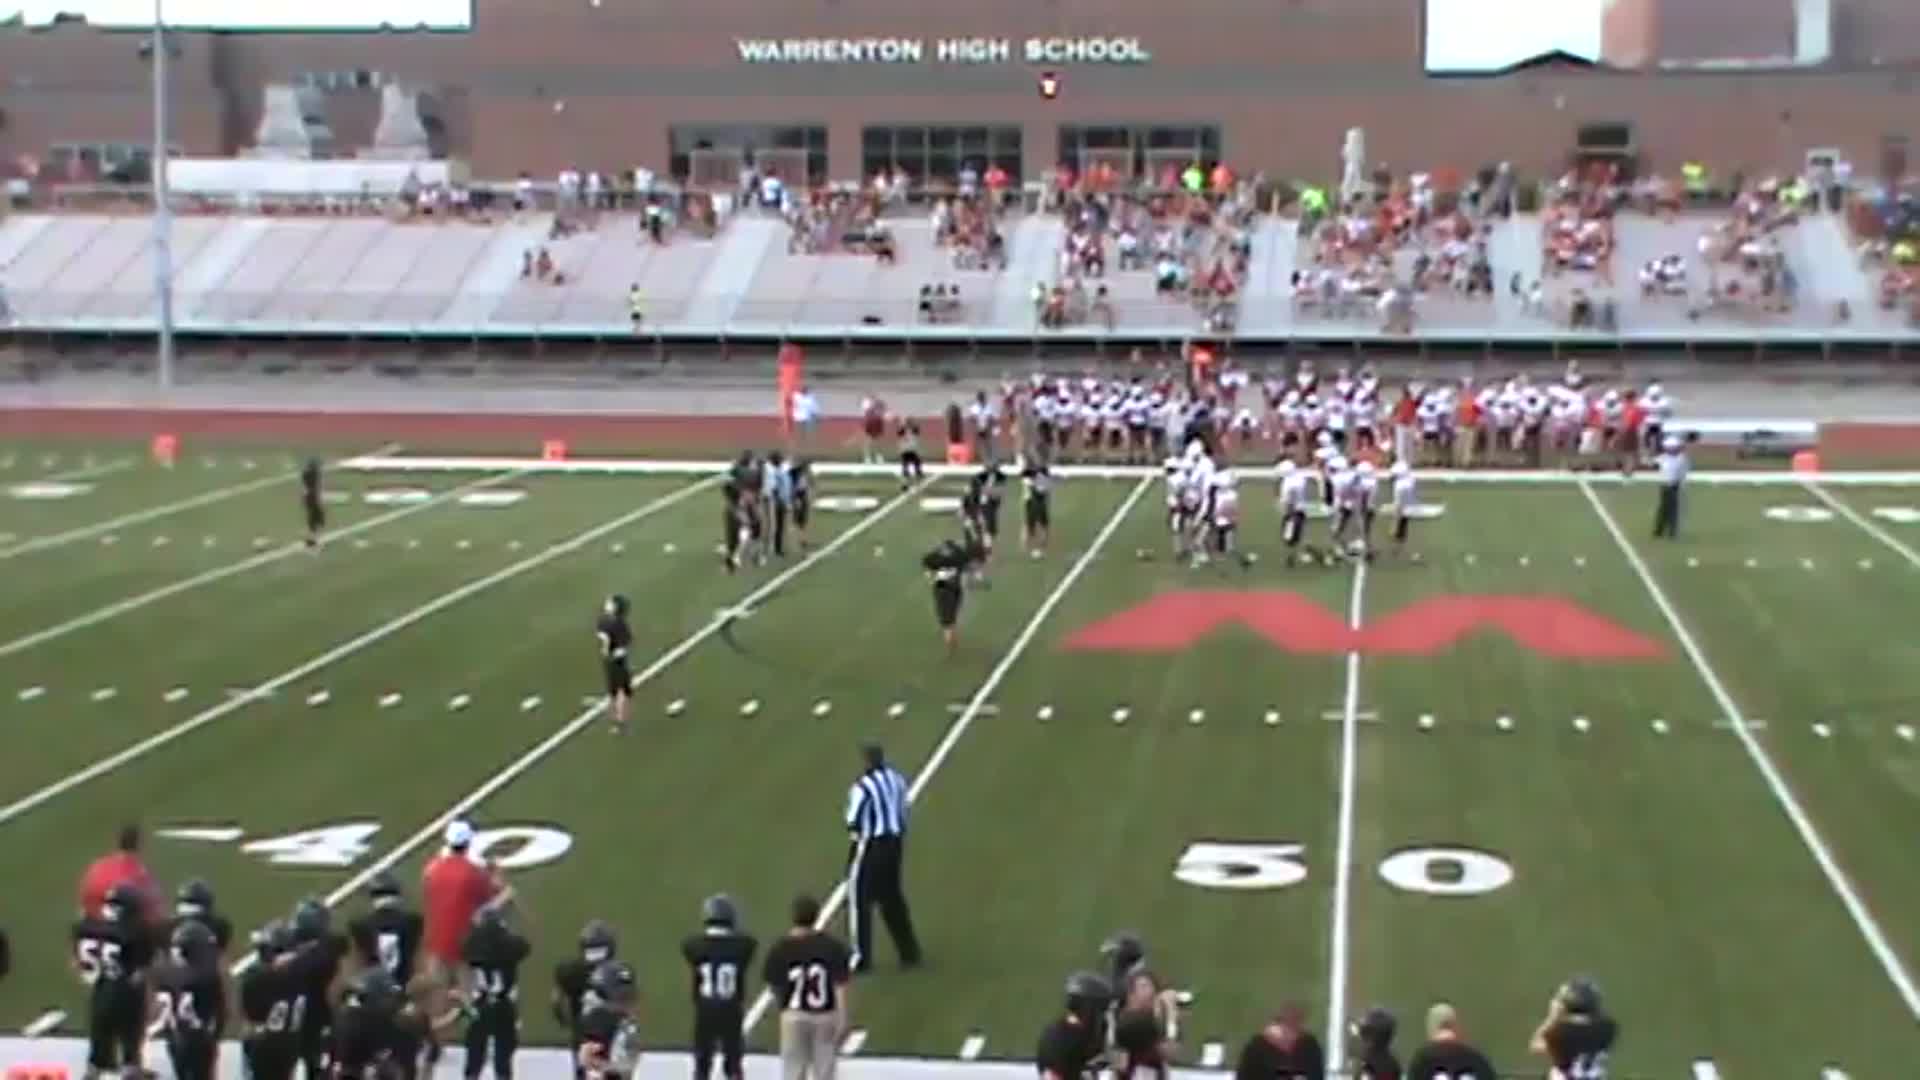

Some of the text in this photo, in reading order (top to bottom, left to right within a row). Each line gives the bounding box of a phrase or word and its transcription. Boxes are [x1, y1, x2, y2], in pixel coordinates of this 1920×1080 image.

[736, 38, 1150, 63] WARRENTON HIGH SCHOOL
[78, 938, 123, 985] 55
[699, 962, 737, 998] 10
[787, 964, 827, 1009] 73
